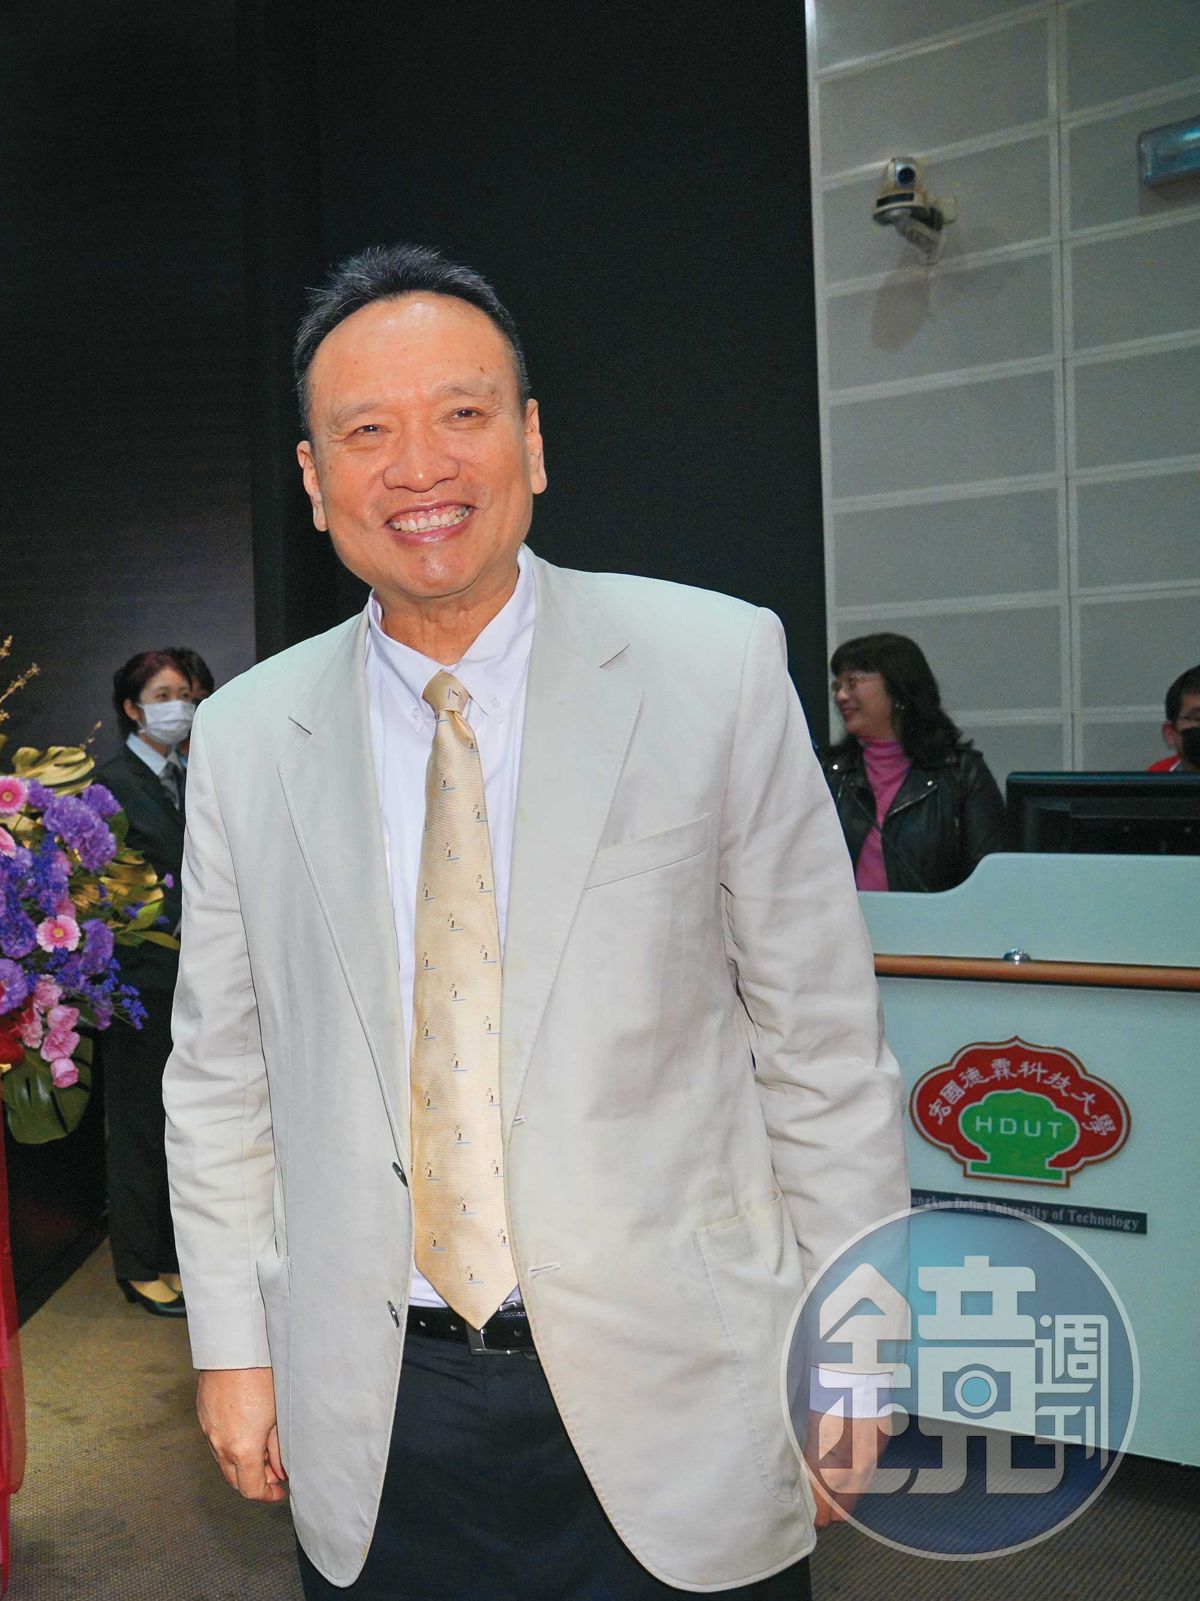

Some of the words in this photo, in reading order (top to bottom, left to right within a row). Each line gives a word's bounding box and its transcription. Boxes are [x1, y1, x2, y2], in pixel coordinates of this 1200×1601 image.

[929, 1057, 1117, 1137] 宏國德霖科技大學
[975, 1115, 1063, 1139] HDUT
[1052, 1207, 1064, 1221] of
[1067, 1209, 1140, 1231] Technology
